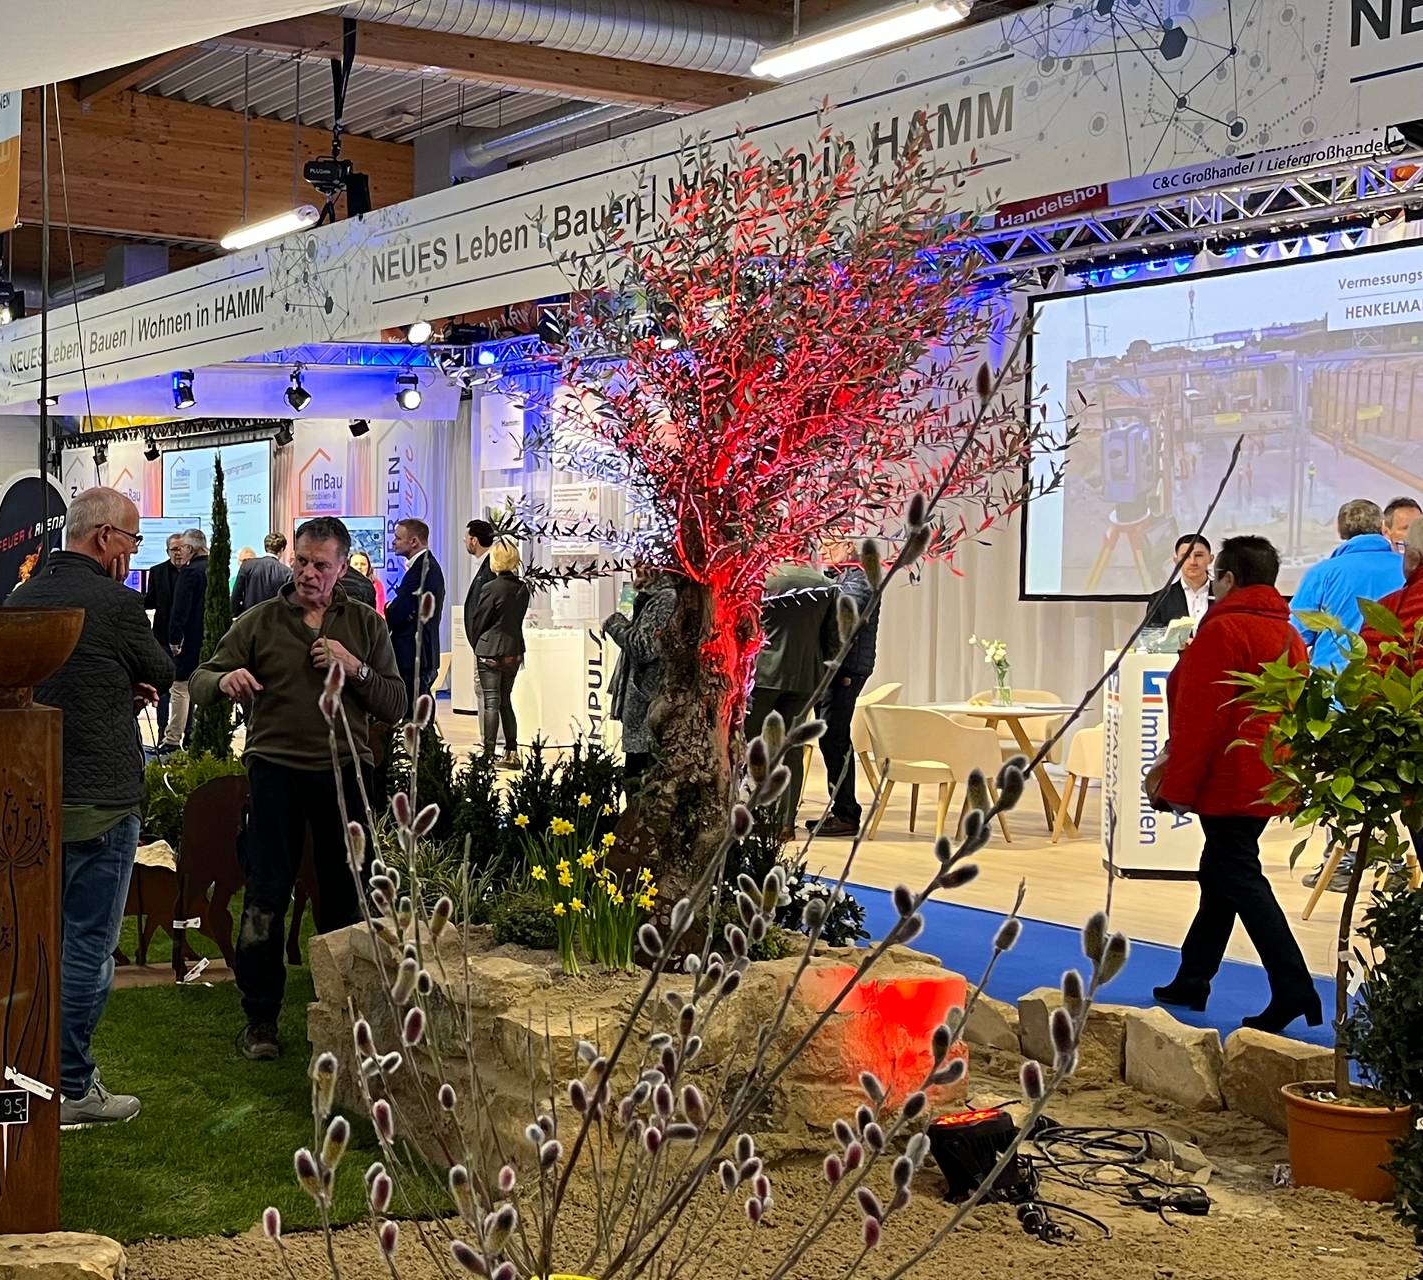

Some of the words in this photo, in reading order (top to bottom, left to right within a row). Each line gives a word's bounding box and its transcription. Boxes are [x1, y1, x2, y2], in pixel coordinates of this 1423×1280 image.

[372, 238, 448, 285] NEUES
[456, 225, 529, 264] Leben
[554, 197, 636, 241] Bauen
[669, 153, 808, 206] Wohen
[871, 86, 1014, 166] HAMM
[1152, 173, 1179, 190] C&C
[1182, 161, 1255, 185] Großhandel
[9, 347, 42, 374] NEUES
[47, 341, 79, 364] Leben
[90, 331, 127, 355] Bauen
[138, 313, 191, 342] Wohnen
[196, 302, 209, 328] in
[214, 285, 265, 323] HAMM
[1338, 270, 1423, 291] Vermessungs
[311, 472, 343, 490] ImBau
[386, 445, 401, 595] XPERTEN-
[588, 629, 603, 740] MPULS
[1139, 708, 1164, 845] Immoien
